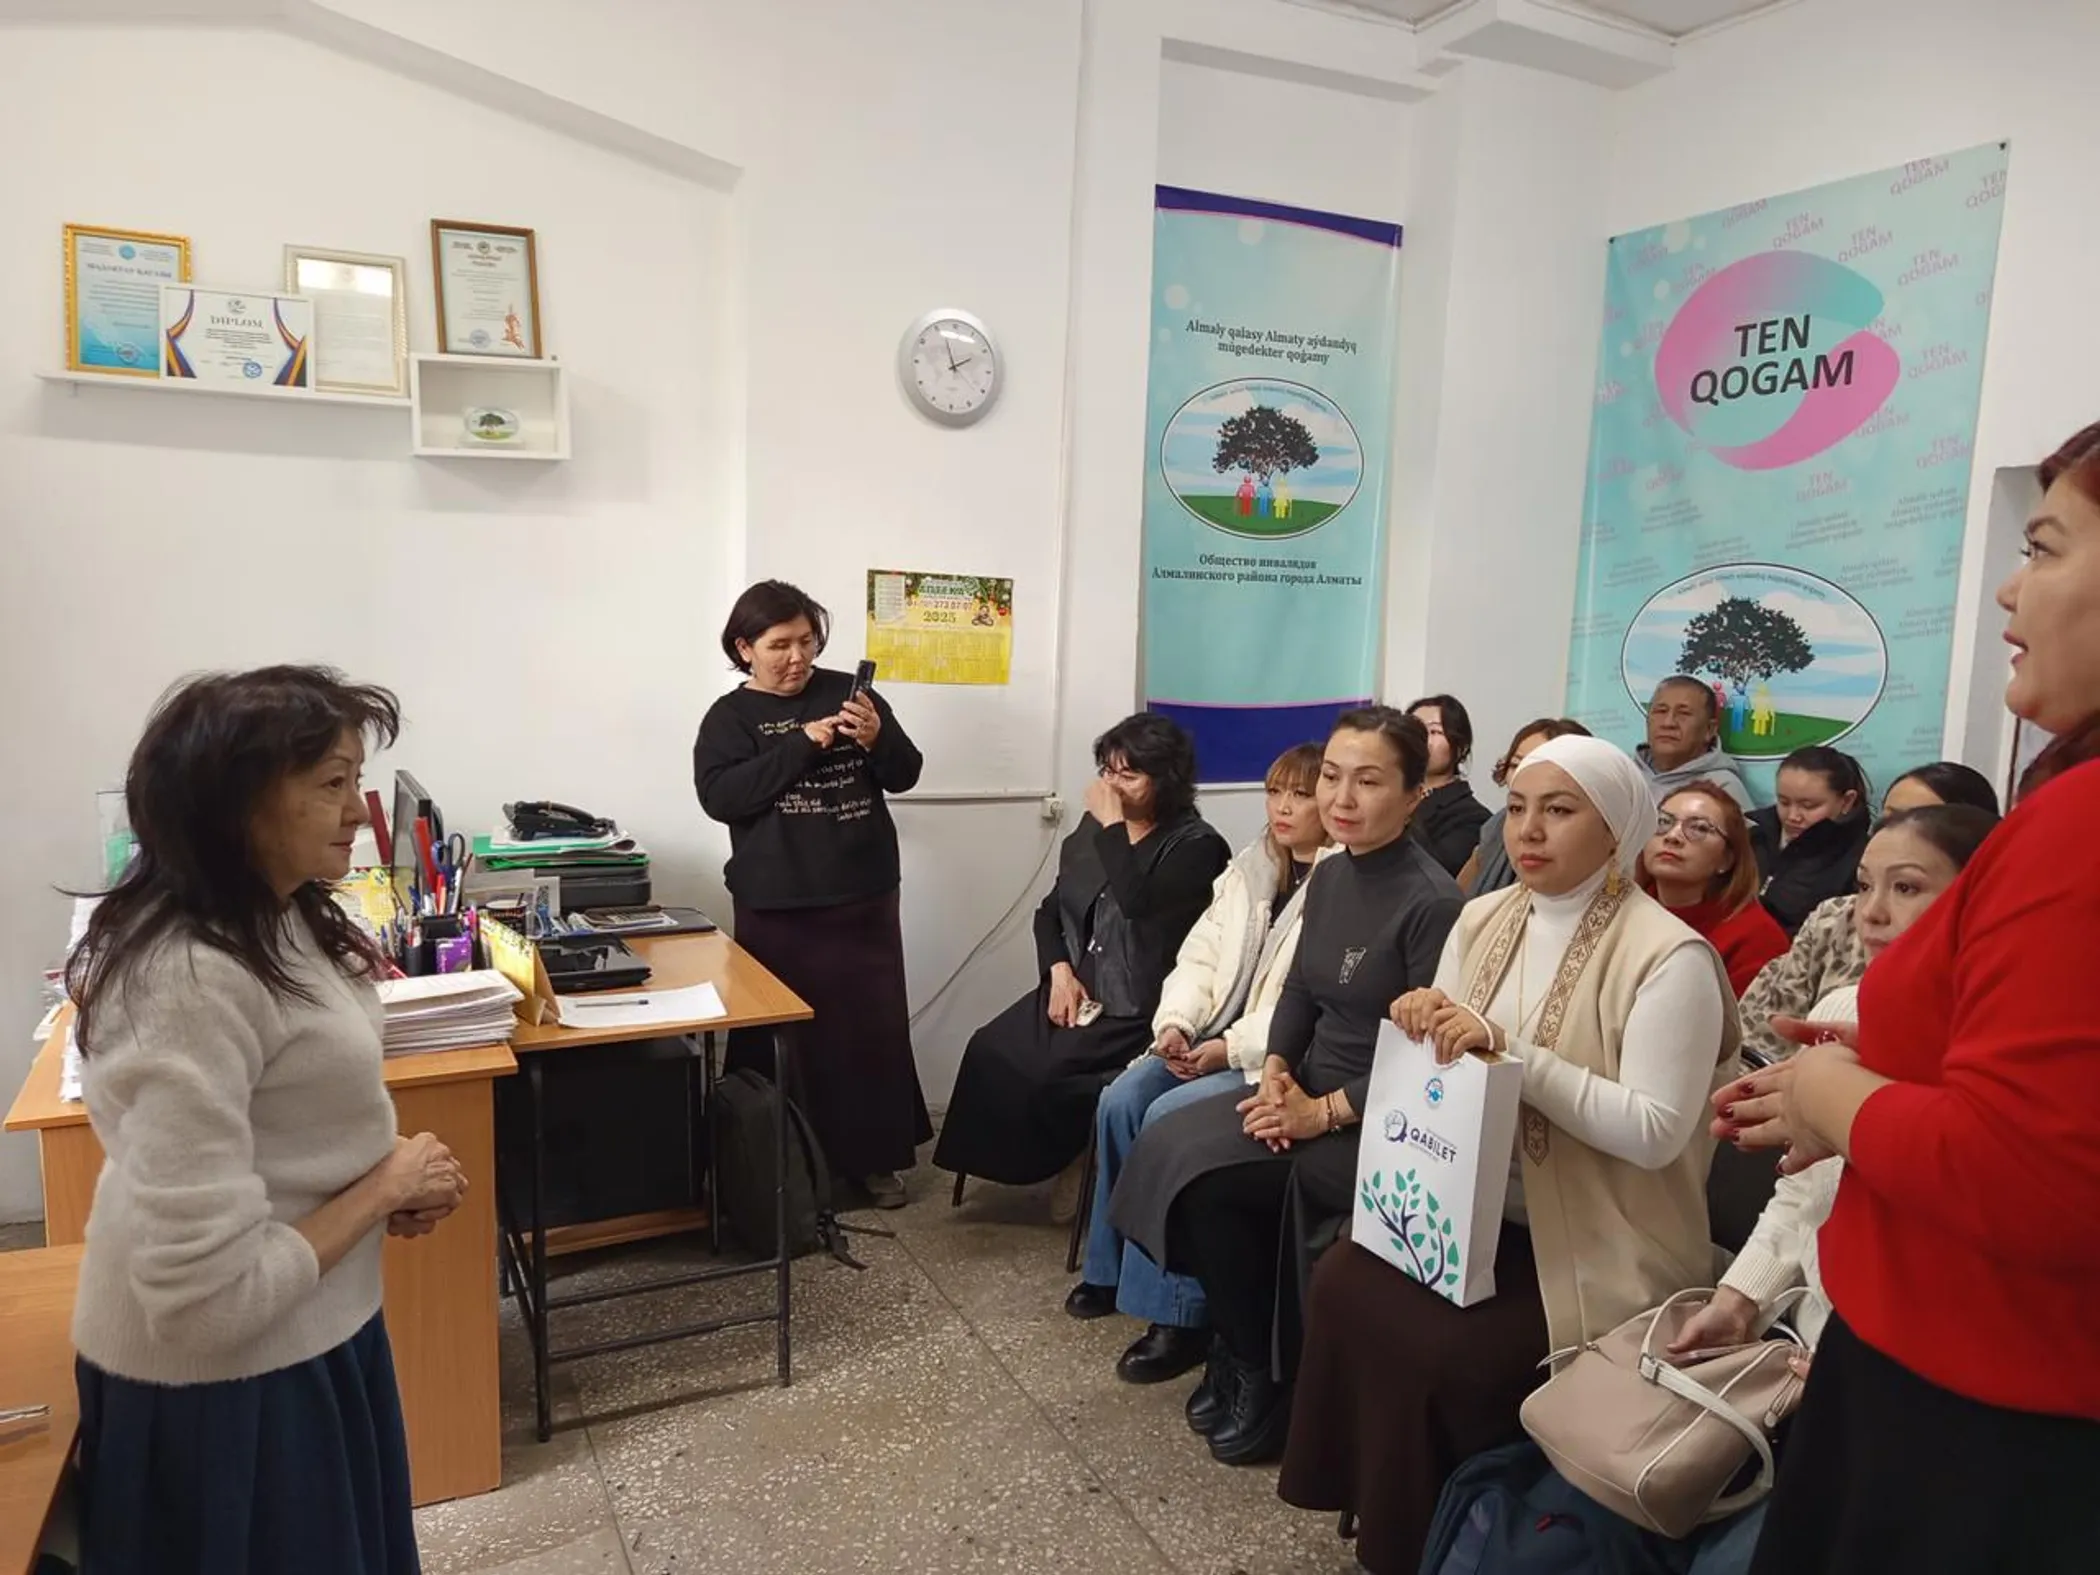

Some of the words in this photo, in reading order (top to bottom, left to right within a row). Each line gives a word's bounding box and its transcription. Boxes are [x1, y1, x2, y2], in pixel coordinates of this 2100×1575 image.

[210, 315, 263, 328] DIPLOM
[1185, 319, 1225, 338] Almaly
[1227, 327, 1262, 341] qalasy
[1264, 329, 1308, 347] Almaty
[1734, 314, 1811, 358] TEN
[1690, 350, 1854, 406] QOGAM
[1199, 553, 1256, 567] Общество
[1152, 566, 1235, 582] Алмалинского
[1237, 568, 1278, 585] района
[1280, 572, 1314, 586] города
[1316, 573, 1363, 586] Алматы
[923, 610, 957, 623] 2025
[1410, 1126, 1457, 1163] QABILET
